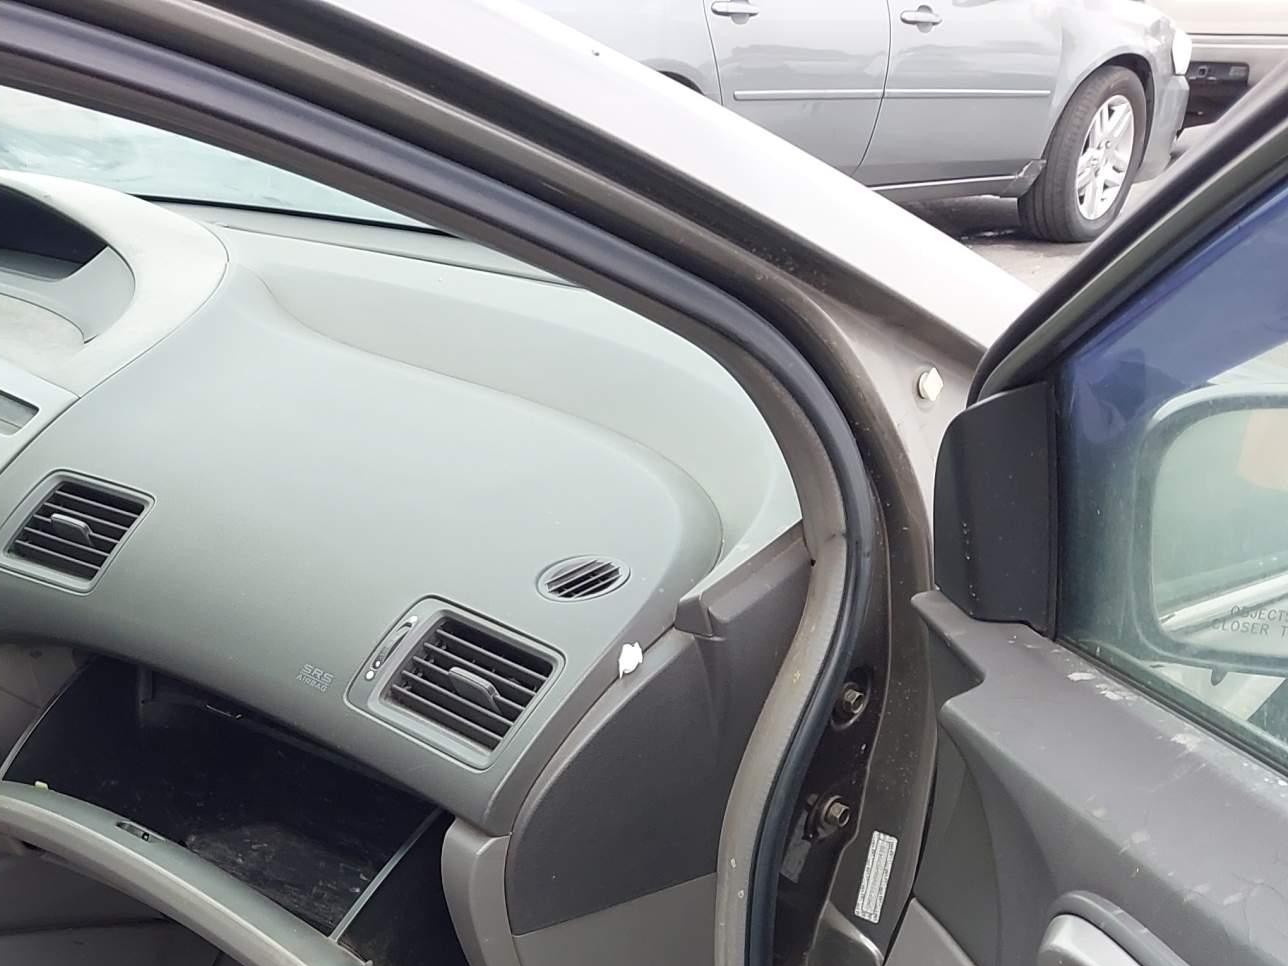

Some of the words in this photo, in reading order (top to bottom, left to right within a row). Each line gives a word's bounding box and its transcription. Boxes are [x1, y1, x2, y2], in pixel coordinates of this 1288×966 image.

[1211, 618, 1270, 636] CLOSER
[302, 663, 334, 683] SRS
[295, 674, 328, 692] AIRBAG
